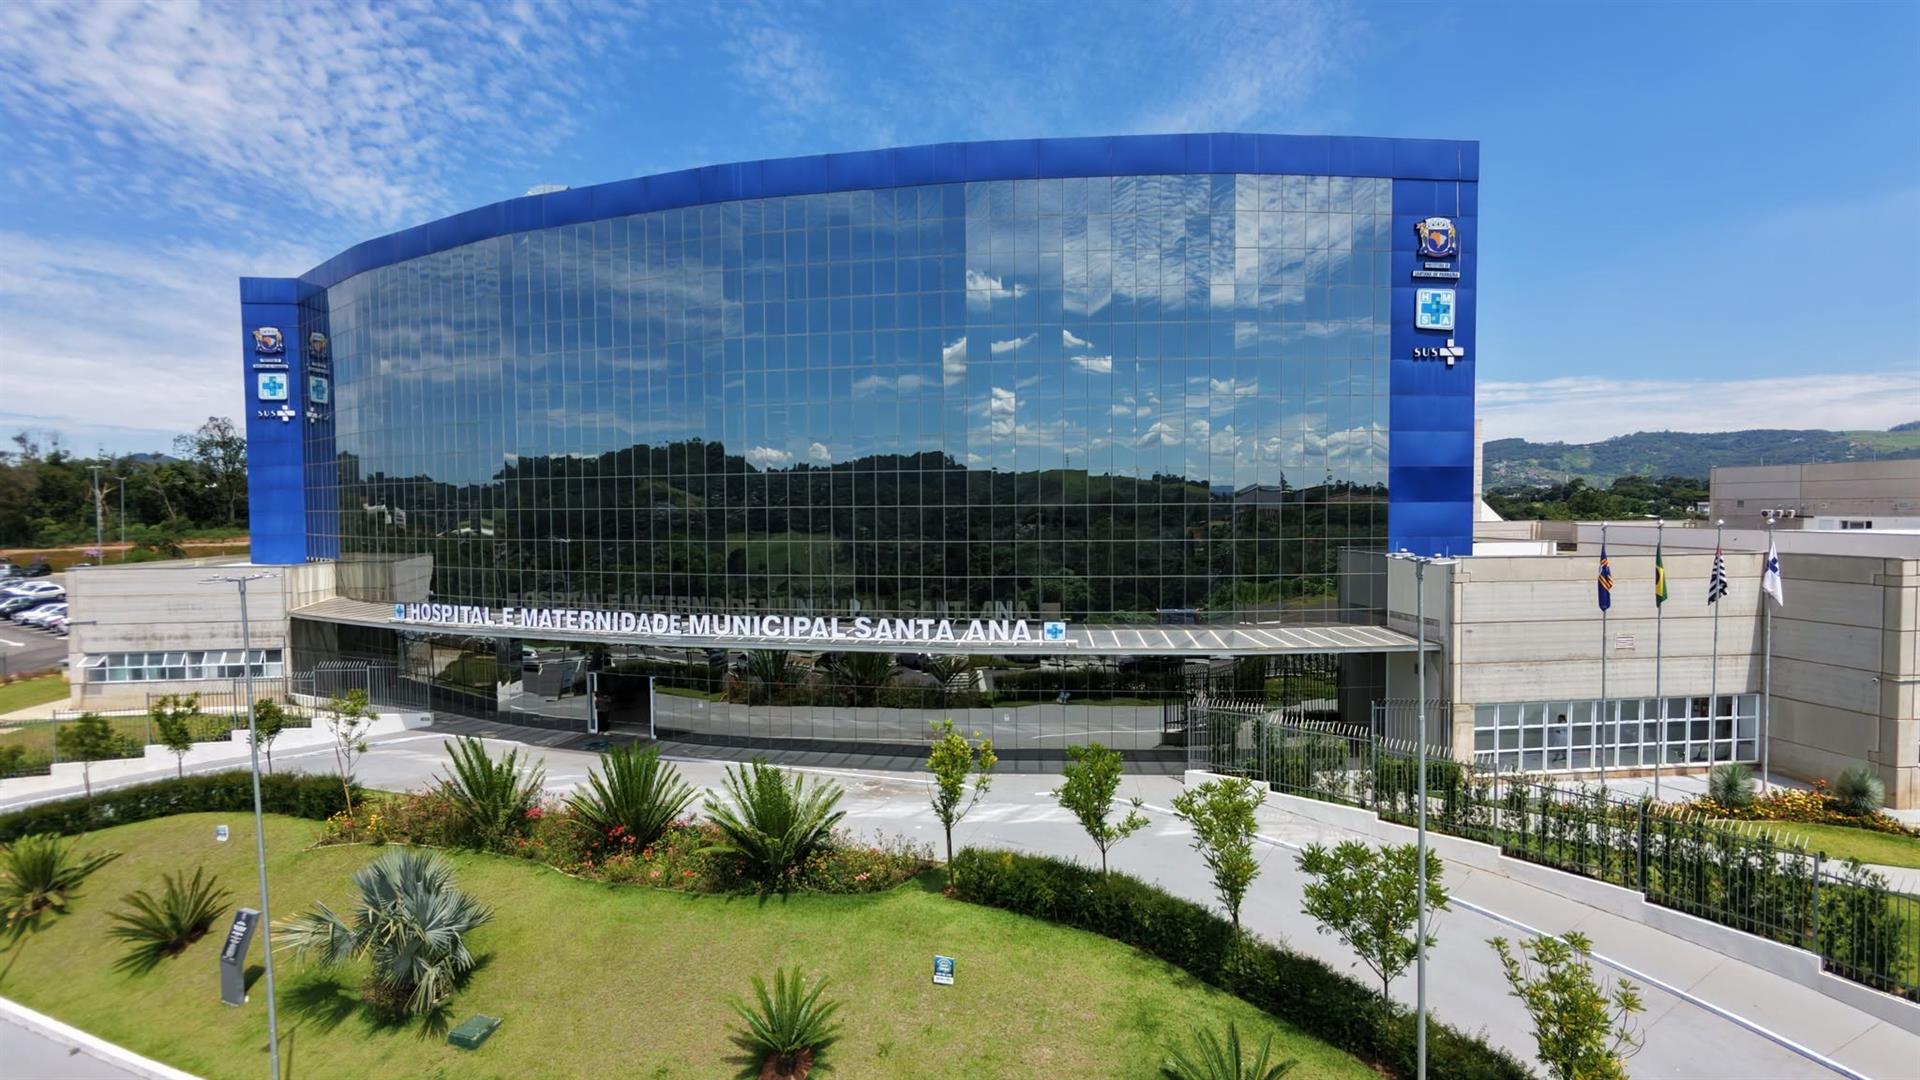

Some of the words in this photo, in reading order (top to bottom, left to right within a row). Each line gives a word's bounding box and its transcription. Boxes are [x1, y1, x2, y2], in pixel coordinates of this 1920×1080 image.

[1414, 347, 1438, 357] SUS
[410, 603, 496, 625] HOSPITAL
[503, 608, 514, 626] E
[521, 608, 682, 635] MATERNIDADE
[689, 614, 847, 638] MUNICIPAL
[854, 617, 955, 640] SANTA
[966, 619, 1032, 641] ANA
